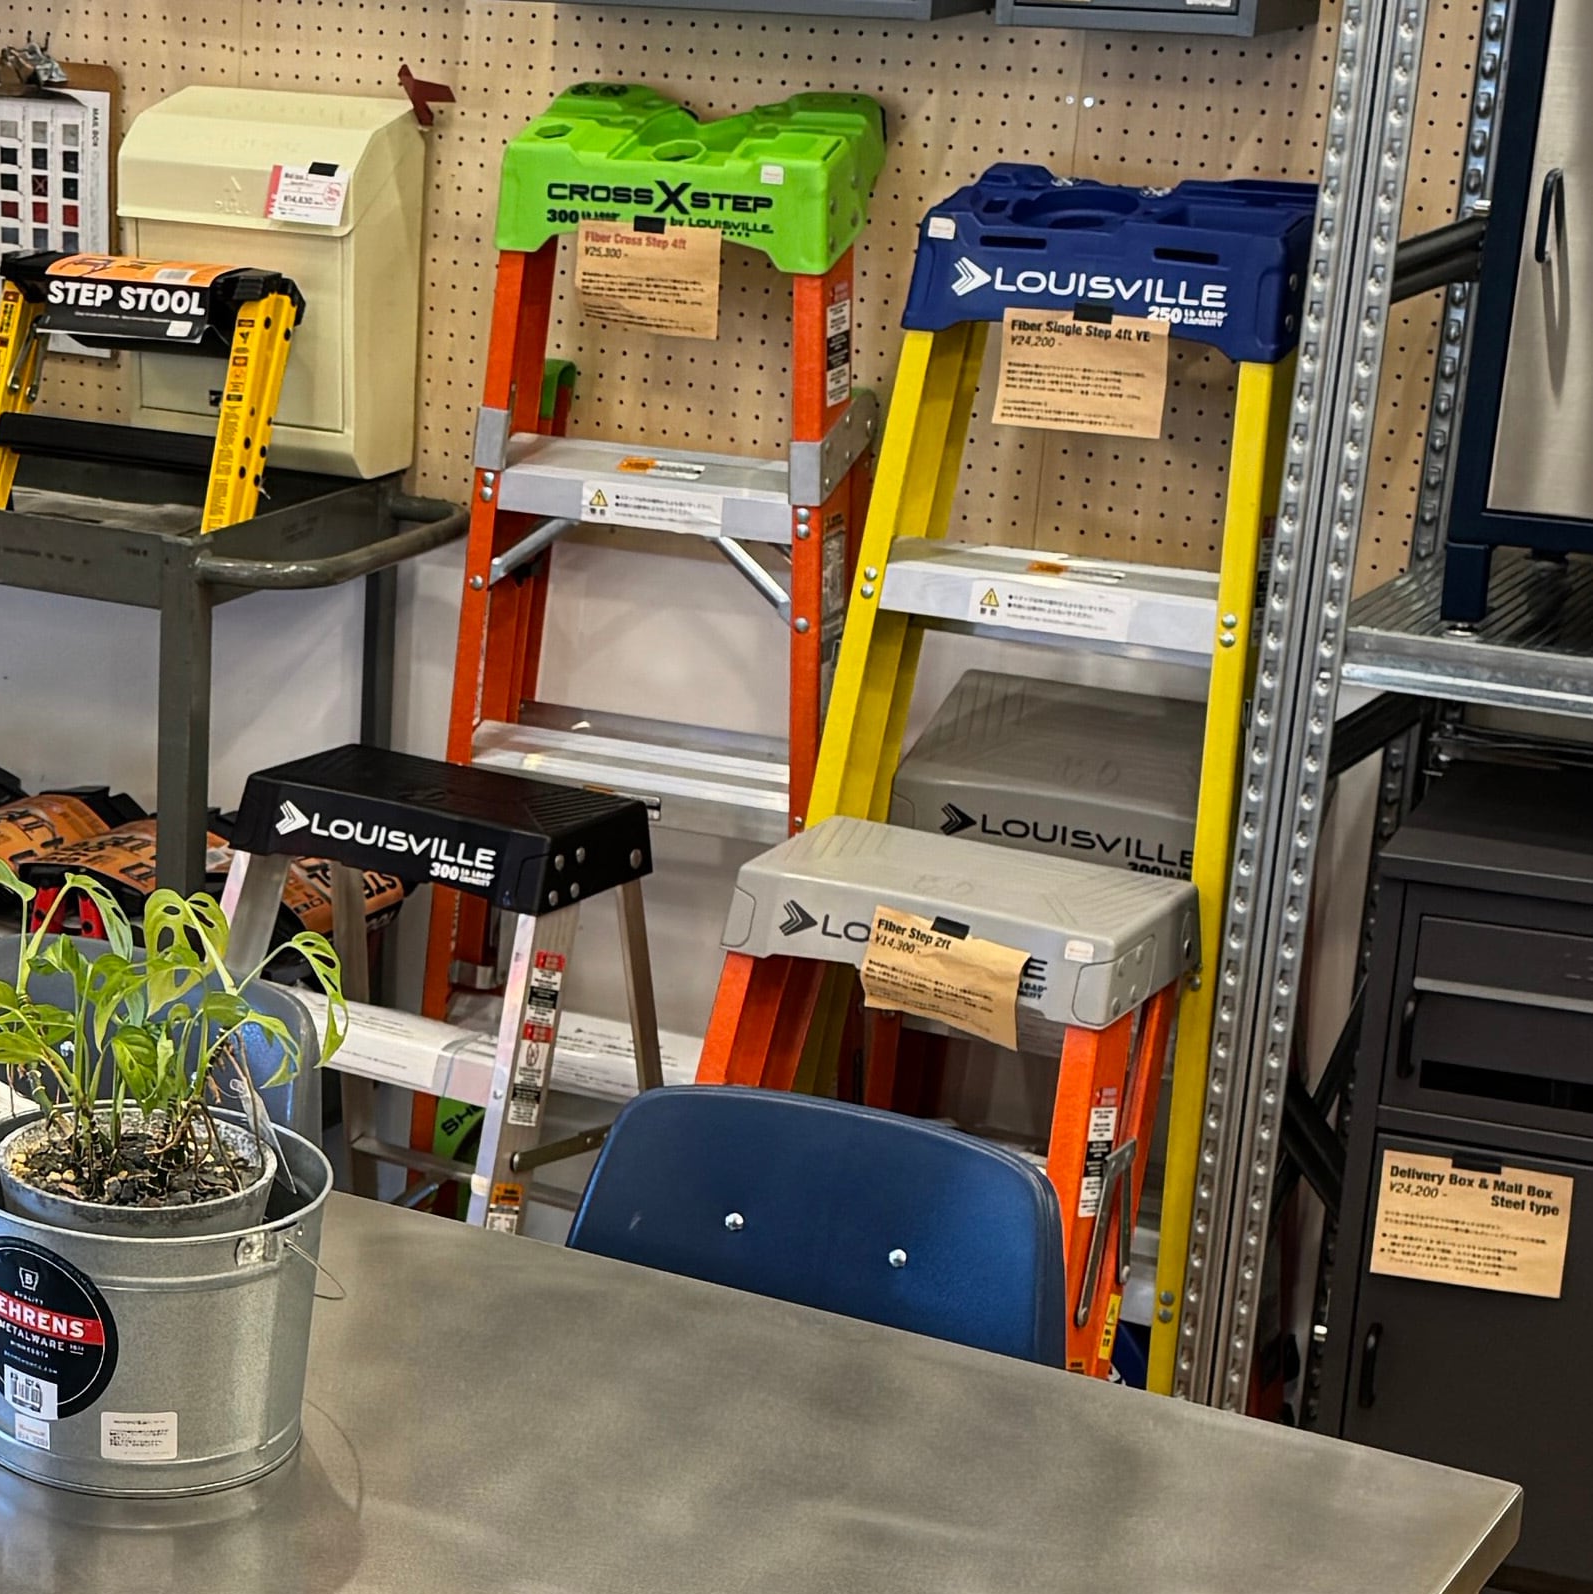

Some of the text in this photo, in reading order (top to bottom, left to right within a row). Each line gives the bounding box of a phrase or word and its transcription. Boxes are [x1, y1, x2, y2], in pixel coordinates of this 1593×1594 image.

[546, 209, 579, 223] 300
[689, 217, 774, 234] LOUISVILLE
[585, 231, 613, 244] Fiber
[614, 234, 643, 247] Cross
[645, 236, 669, 250] Step
[47, 280, 206, 316] STEP STOOL
[994, 267, 1227, 308] LOUISVILLE
[1147, 306, 1183, 324] 250
[1011, 320, 1043, 332] Fiber
[1045, 321, 1083, 337] Single
[1085, 325, 1112, 340] Step
[1115, 328, 1132, 341] 4ft
[1011, 335, 1056, 348] ¥24,200
[310, 812, 497, 871] LOUISVILLE
[981, 814, 1194, 868] LOUISVILLE
[429, 862, 460, 881] 300
[877, 918, 908, 937] Fiber
[909, 927, 934, 947] Step
[1389, 1181, 1439, 1199] ¥24,200
[1390, 1165, 1553, 1200] Delivery Box & Mail Box
[1491, 1195, 1560, 1217] Steel type
[0, 1319, 65, 1352] METALWARE
